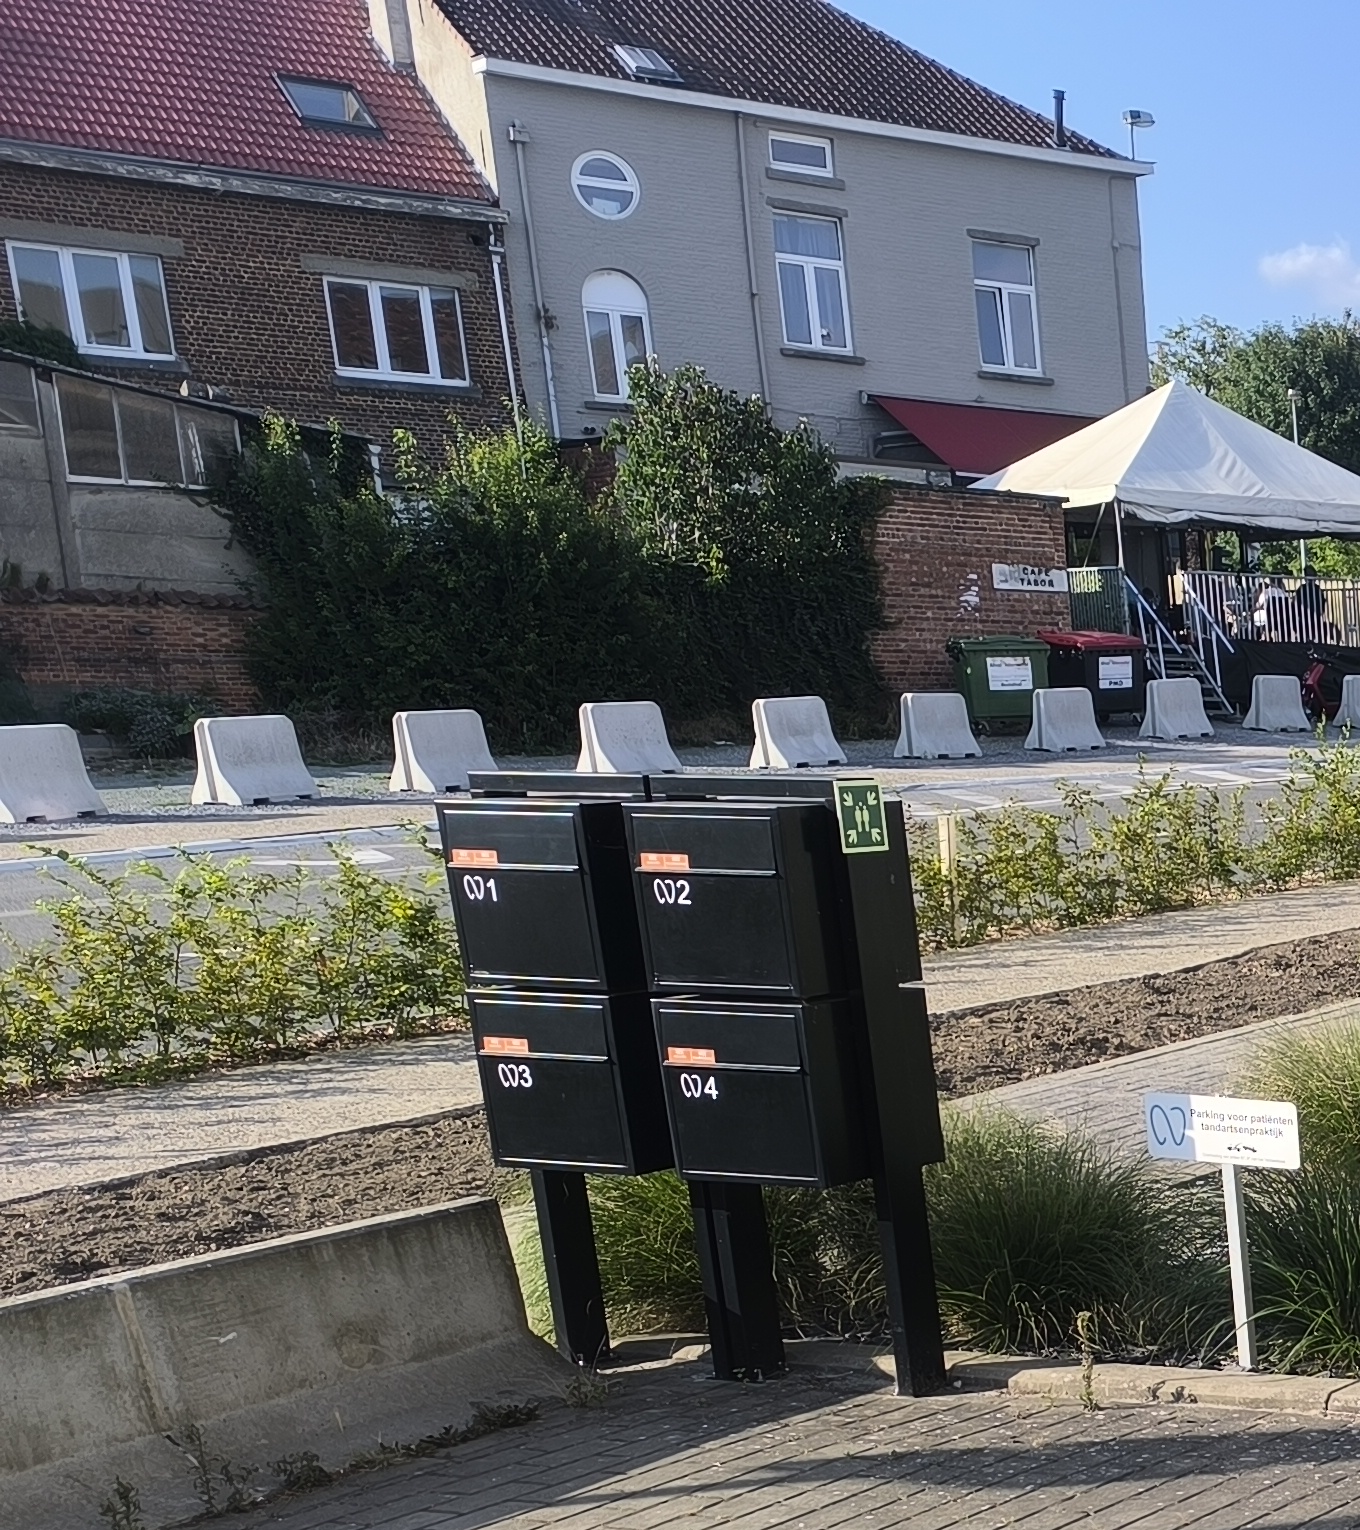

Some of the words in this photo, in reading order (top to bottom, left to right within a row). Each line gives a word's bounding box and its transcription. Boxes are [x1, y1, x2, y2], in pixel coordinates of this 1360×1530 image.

[1020, 578, 1054, 588] TABOR
[1190, 1108, 1225, 1122] Parking
[1227, 1114, 1248, 1122] voor
[1201, 1122, 1284, 1138] tandartsenpraktijk
